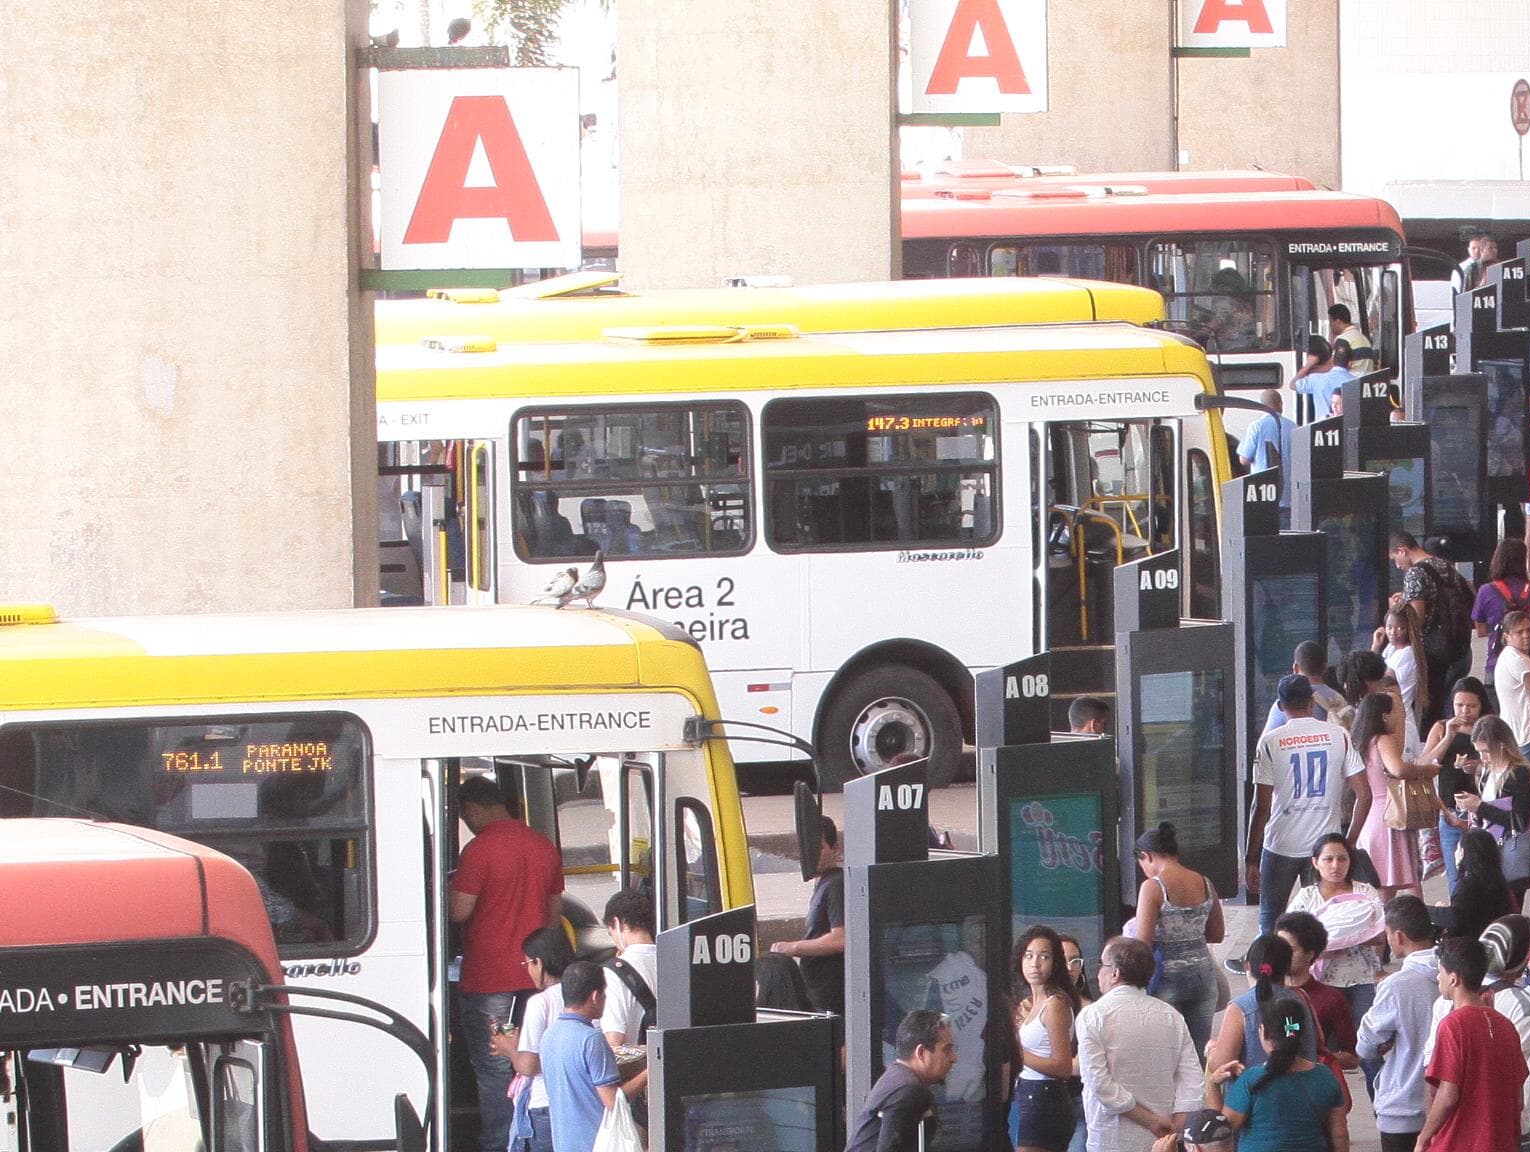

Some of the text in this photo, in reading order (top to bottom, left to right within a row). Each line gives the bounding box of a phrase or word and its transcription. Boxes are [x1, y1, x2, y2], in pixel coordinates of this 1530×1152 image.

[924, 0, 1032, 94] A
[402, 95, 561, 244] A
[1289, 242, 1389, 253] ENTRADA ENTRANCE
[1503, 267, 1524, 280] A 15
[1473, 295, 1495, 309] A 14
[1424, 335, 1448, 350] A 13
[1030, 391, 1170, 407] ENTRADA-ENTRANCE
[1362, 382, 1387, 398] A 12
[401, 413, 431, 425] EXIT
[867, 416, 910, 431] 147.3
[1314, 429, 1339, 446] A 11
[1246, 484, 1276, 502] A 10
[1140, 569, 1178, 590] A 09
[626, 574, 735, 611] Área 2
[1005, 674, 1049, 699] A 08
[429, 711, 651, 734] ENTRADA-ENTRANCE
[247, 742, 327, 758] PARANOA
[162, 752, 224, 771] 761.1
[242, 757, 332, 773] PONTE JK
[1290, 750, 1328, 799] 10
[878, 784, 924, 810] A 07
[692, 934, 751, 964] A 06
[75, 979, 224, 1010] ENTRANCE
